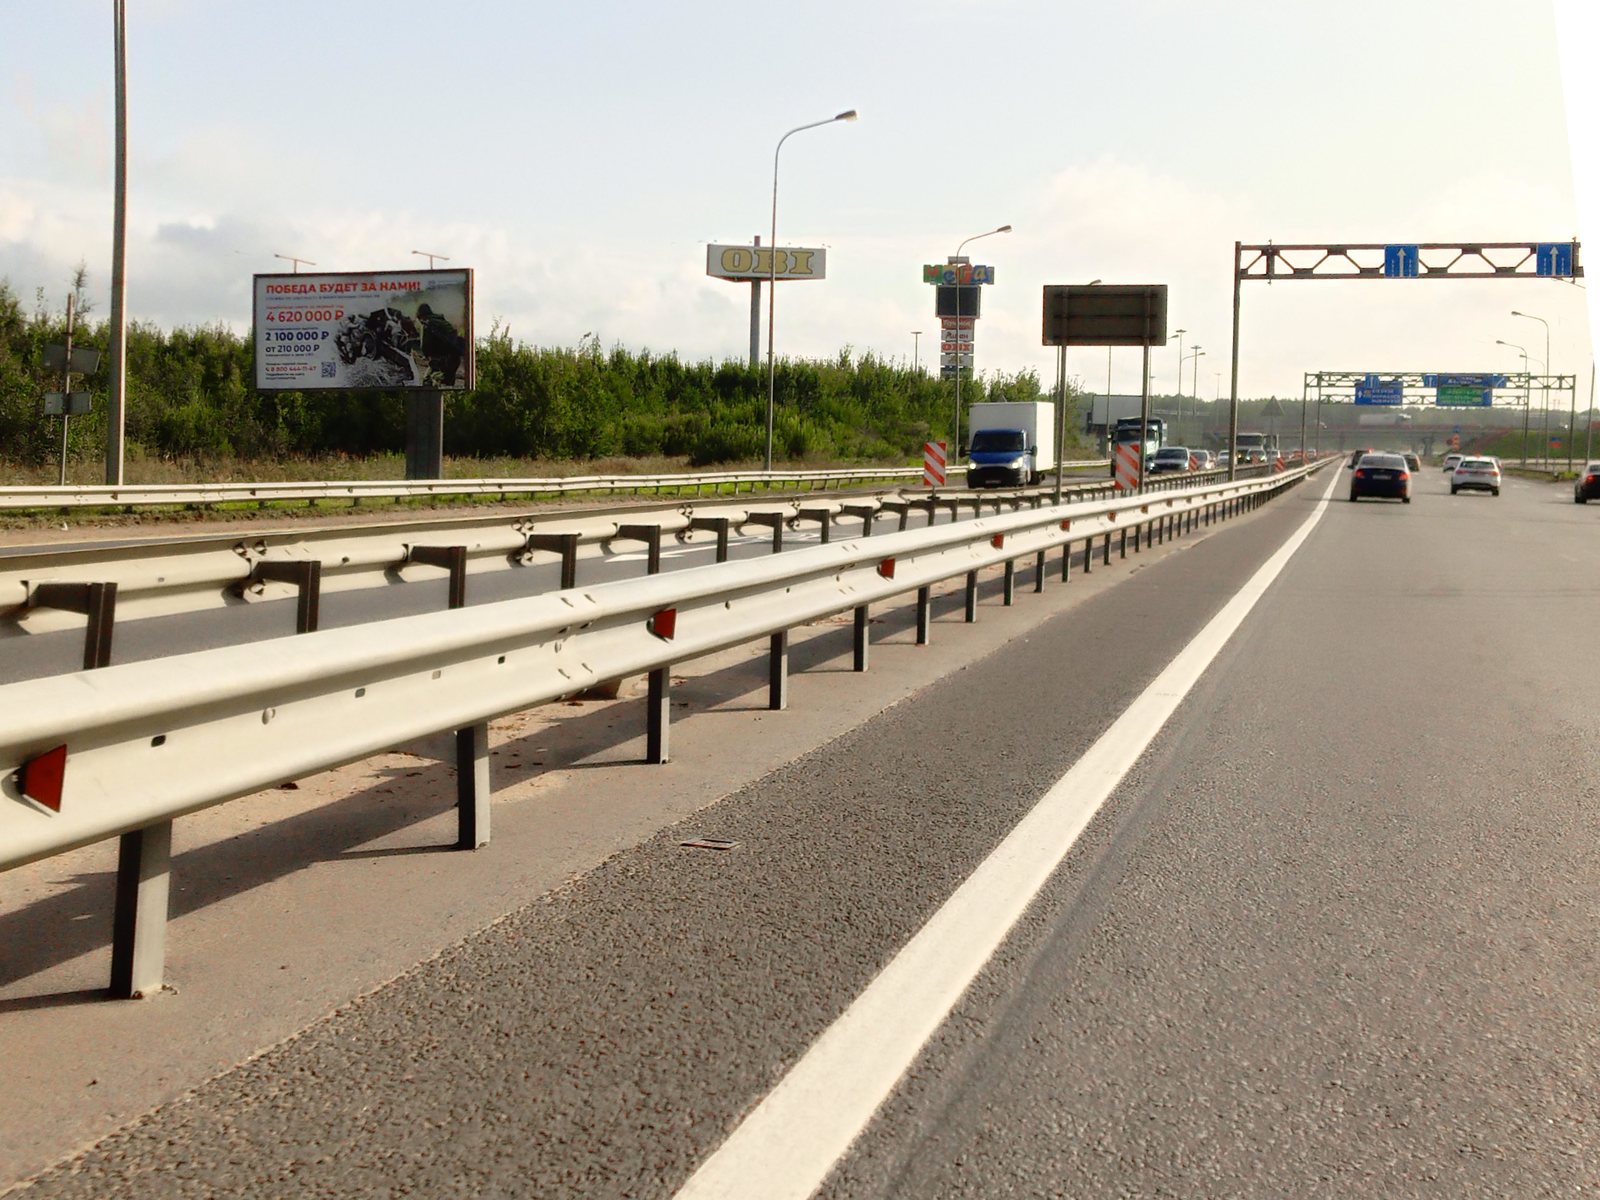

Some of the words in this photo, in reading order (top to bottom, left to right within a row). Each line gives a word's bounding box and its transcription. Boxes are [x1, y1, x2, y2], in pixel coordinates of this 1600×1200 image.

[721, 248, 814, 274] OBI
[266, 284, 316, 294] ПОБЕДА
[320, 283, 358, 293] БУДЕТ
[361, 282, 377, 291] ЗА
[380, 281, 421, 291] НАМИ!
[266, 311, 275, 322] 4
[278, 311, 303, 322] 620
[304, 310, 332, 322] 000
[265, 332, 271, 341] 2
[275, 331, 294, 341] 100
[296, 331, 319, 341] 000
[277, 345, 292, 353] 210
[294, 344, 312, 352] 000
